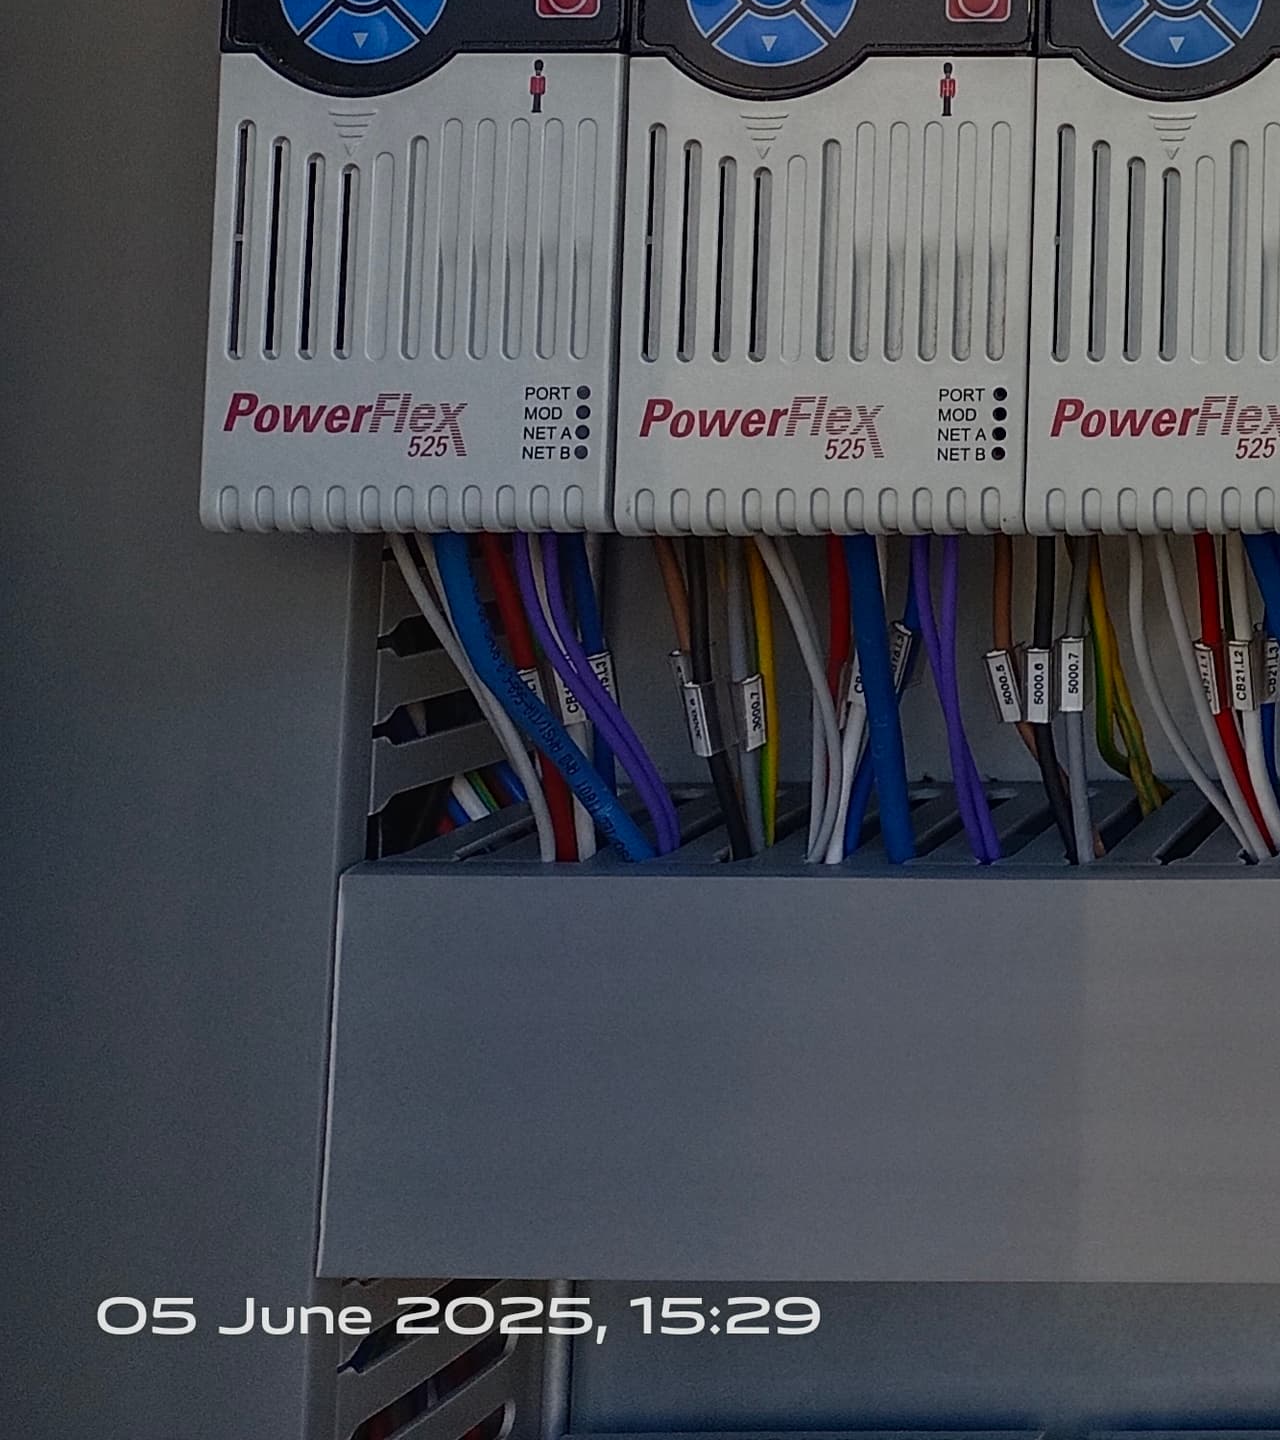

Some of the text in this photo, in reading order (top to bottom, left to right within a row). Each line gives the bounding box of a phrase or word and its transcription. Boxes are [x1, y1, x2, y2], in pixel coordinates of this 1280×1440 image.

[525, 387, 571, 400] PORT
[938, 388, 985, 402] PORT
[524, 406, 563, 421] MOD
[938, 408, 977, 422] MOD
[223, 392, 468, 457] PowerFlex
[639, 395, 884, 459] PowerFlex
[523, 426, 572, 440] NET A
[937, 428, 987, 442] NET A
[407, 435, 449, 457] 525
[522, 446, 571, 460] NET B
[824, 438, 866, 460] 525
[1235, 437, 1277, 460] 525
[936, 448, 986, 462] NET B
[1068, 652, 1079, 694] 5000.7
[1234, 650, 1247, 701] CB21.L2
